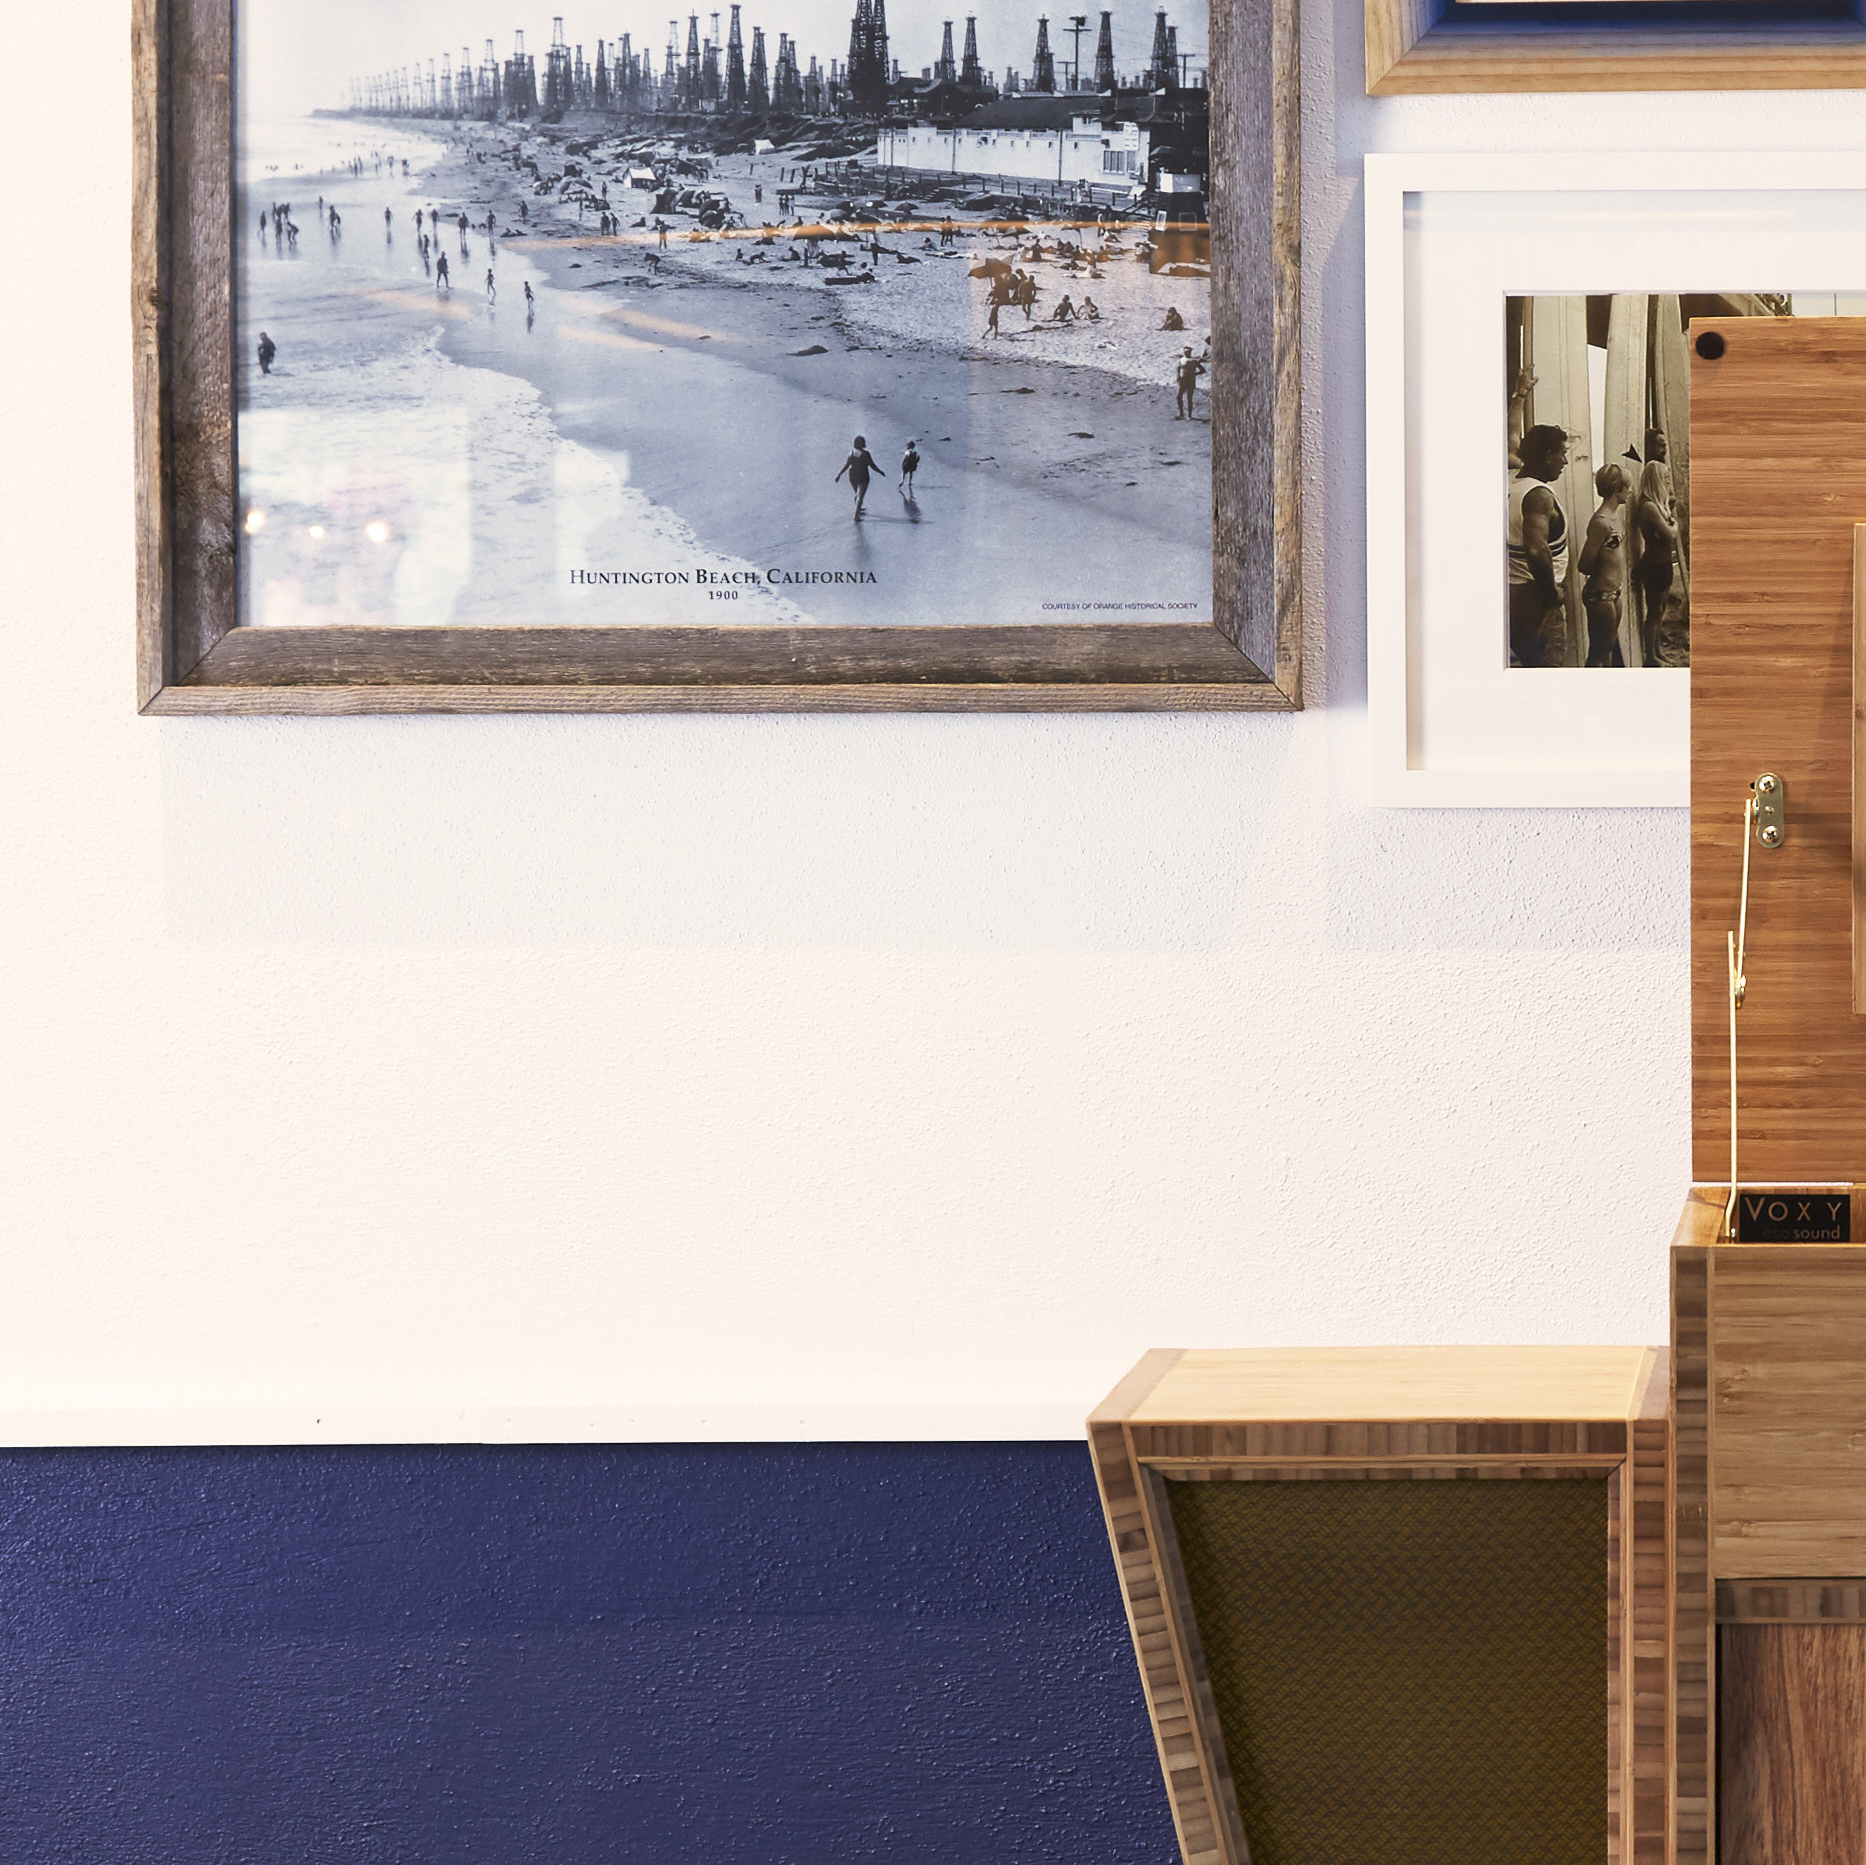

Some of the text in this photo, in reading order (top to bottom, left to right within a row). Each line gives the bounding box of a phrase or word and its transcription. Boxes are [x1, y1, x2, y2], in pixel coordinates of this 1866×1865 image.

[708, 590, 739, 601] 1900
[1041, 603, 1081, 611] COURTESY
[1167, 602, 1199, 610] SOCIETY
[1744, 1197, 1842, 1222] VOXY
[1793, 1224, 1841, 1239] sound
